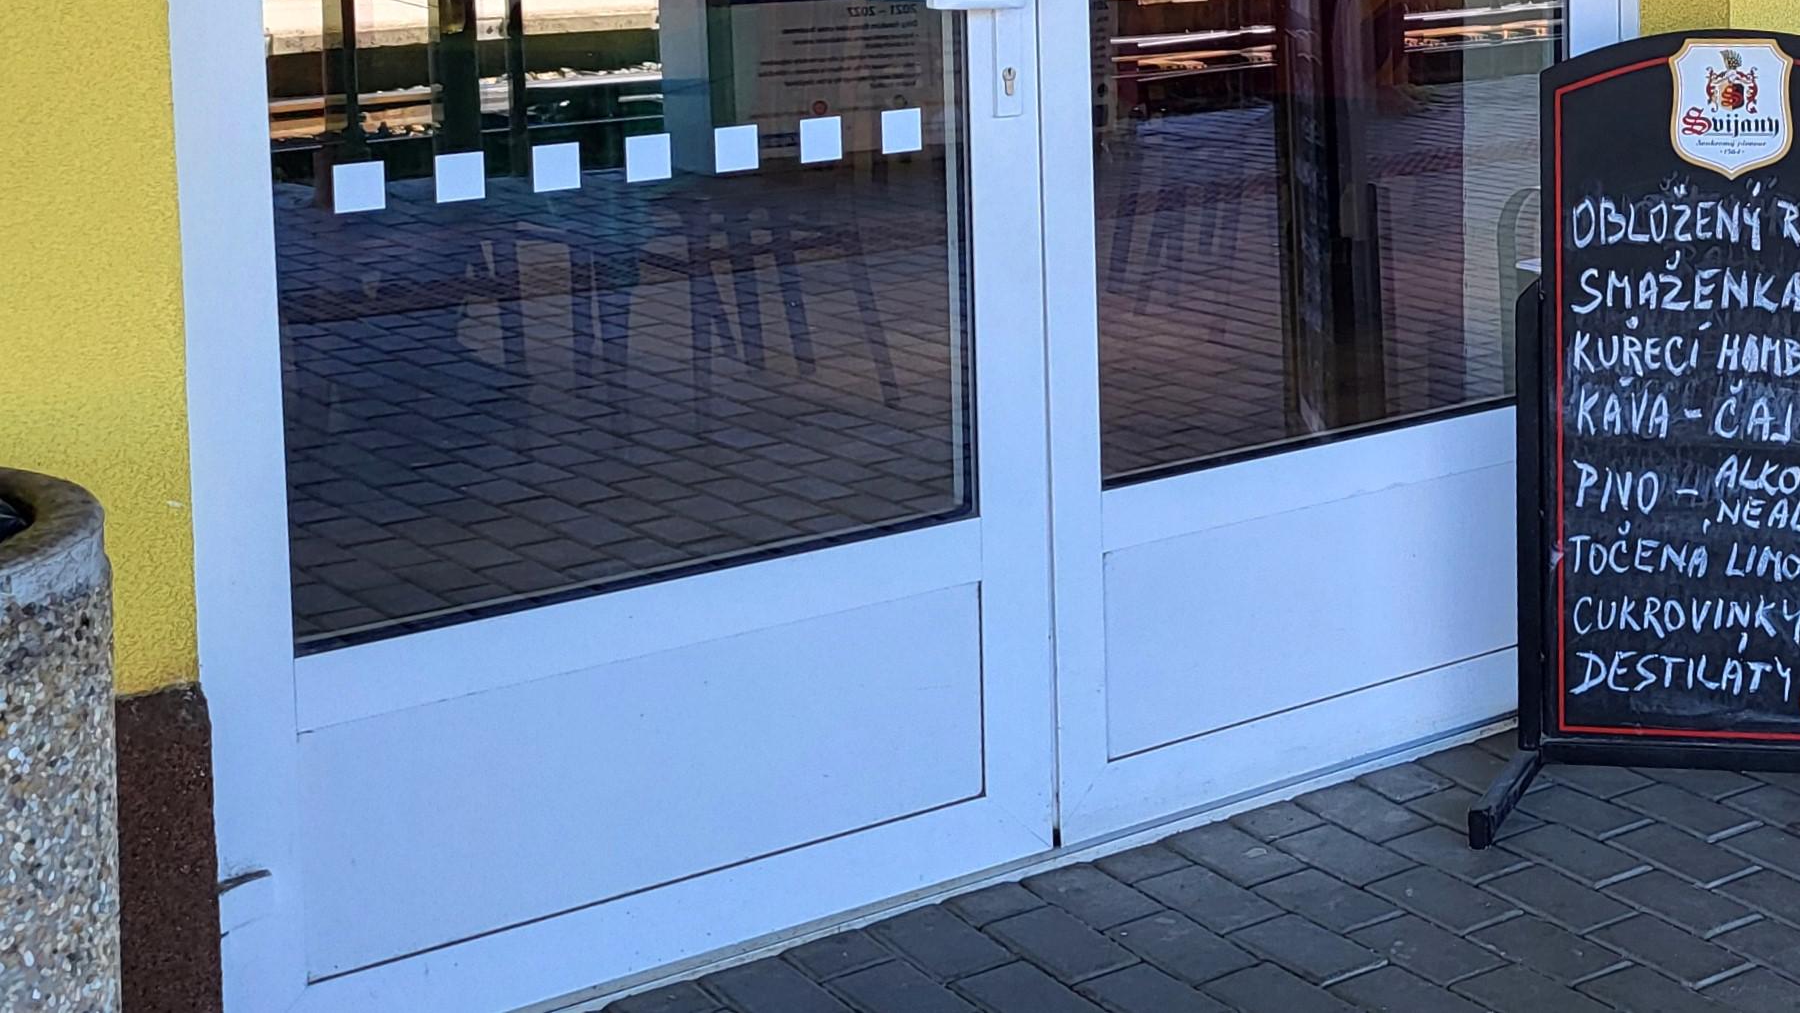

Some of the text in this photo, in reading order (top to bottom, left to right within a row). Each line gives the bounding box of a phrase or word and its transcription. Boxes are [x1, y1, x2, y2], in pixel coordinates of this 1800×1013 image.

[1681, 106, 1780, 138] Svijany
[1573, 181, 1762, 249] OBLOŽENÝ
[1573, 316, 1712, 377] KUŘECÍ
[1577, 376, 1670, 439] KÁVA
[1714, 378, 1794, 445] ČAJ
[1572, 459, 1660, 514] PIVO
